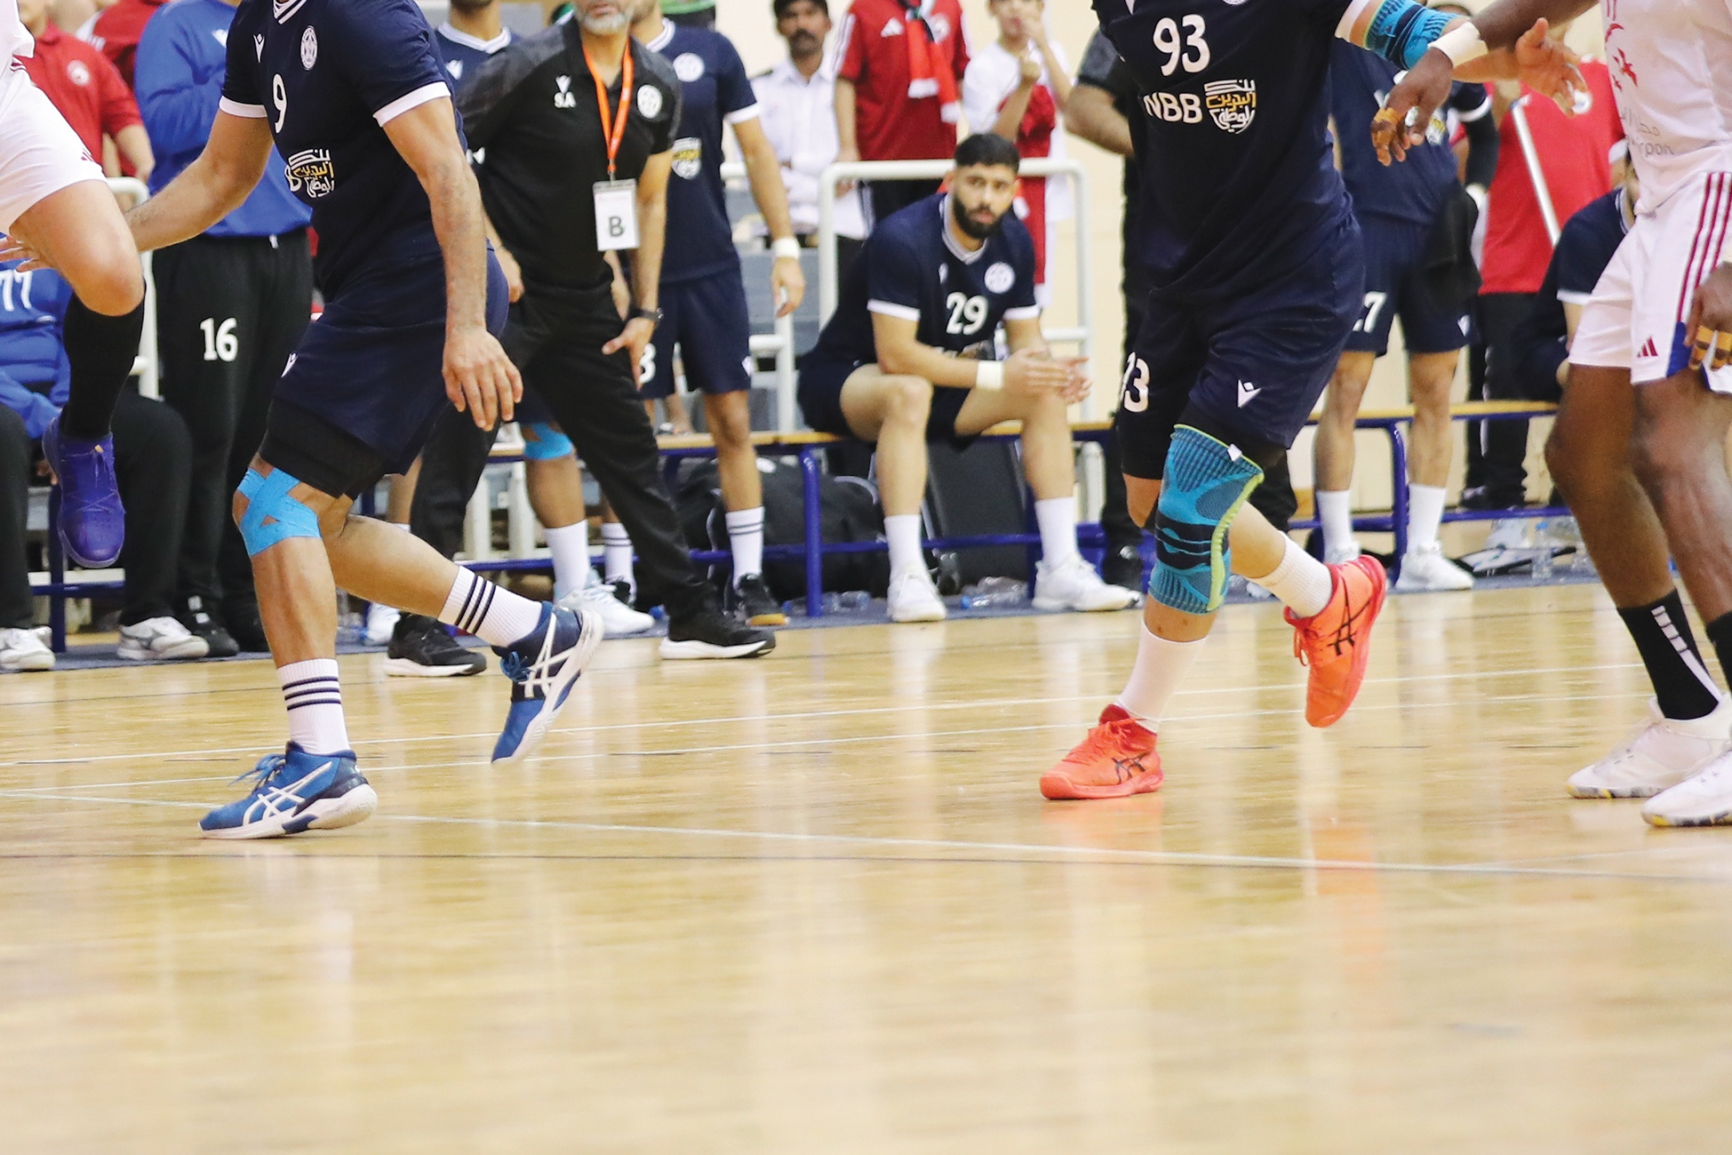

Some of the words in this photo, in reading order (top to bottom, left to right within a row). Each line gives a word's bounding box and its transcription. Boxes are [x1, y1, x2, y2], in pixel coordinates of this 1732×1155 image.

[1153, 14, 1211, 77] 93
[272, 73, 287, 134] 9
[1143, 91, 1203, 124] NBB
[608, 215, 625, 238] B
[946, 291, 988, 335] 29
[1352, 290, 1387, 333] 7
[200, 317, 239, 362] 16
